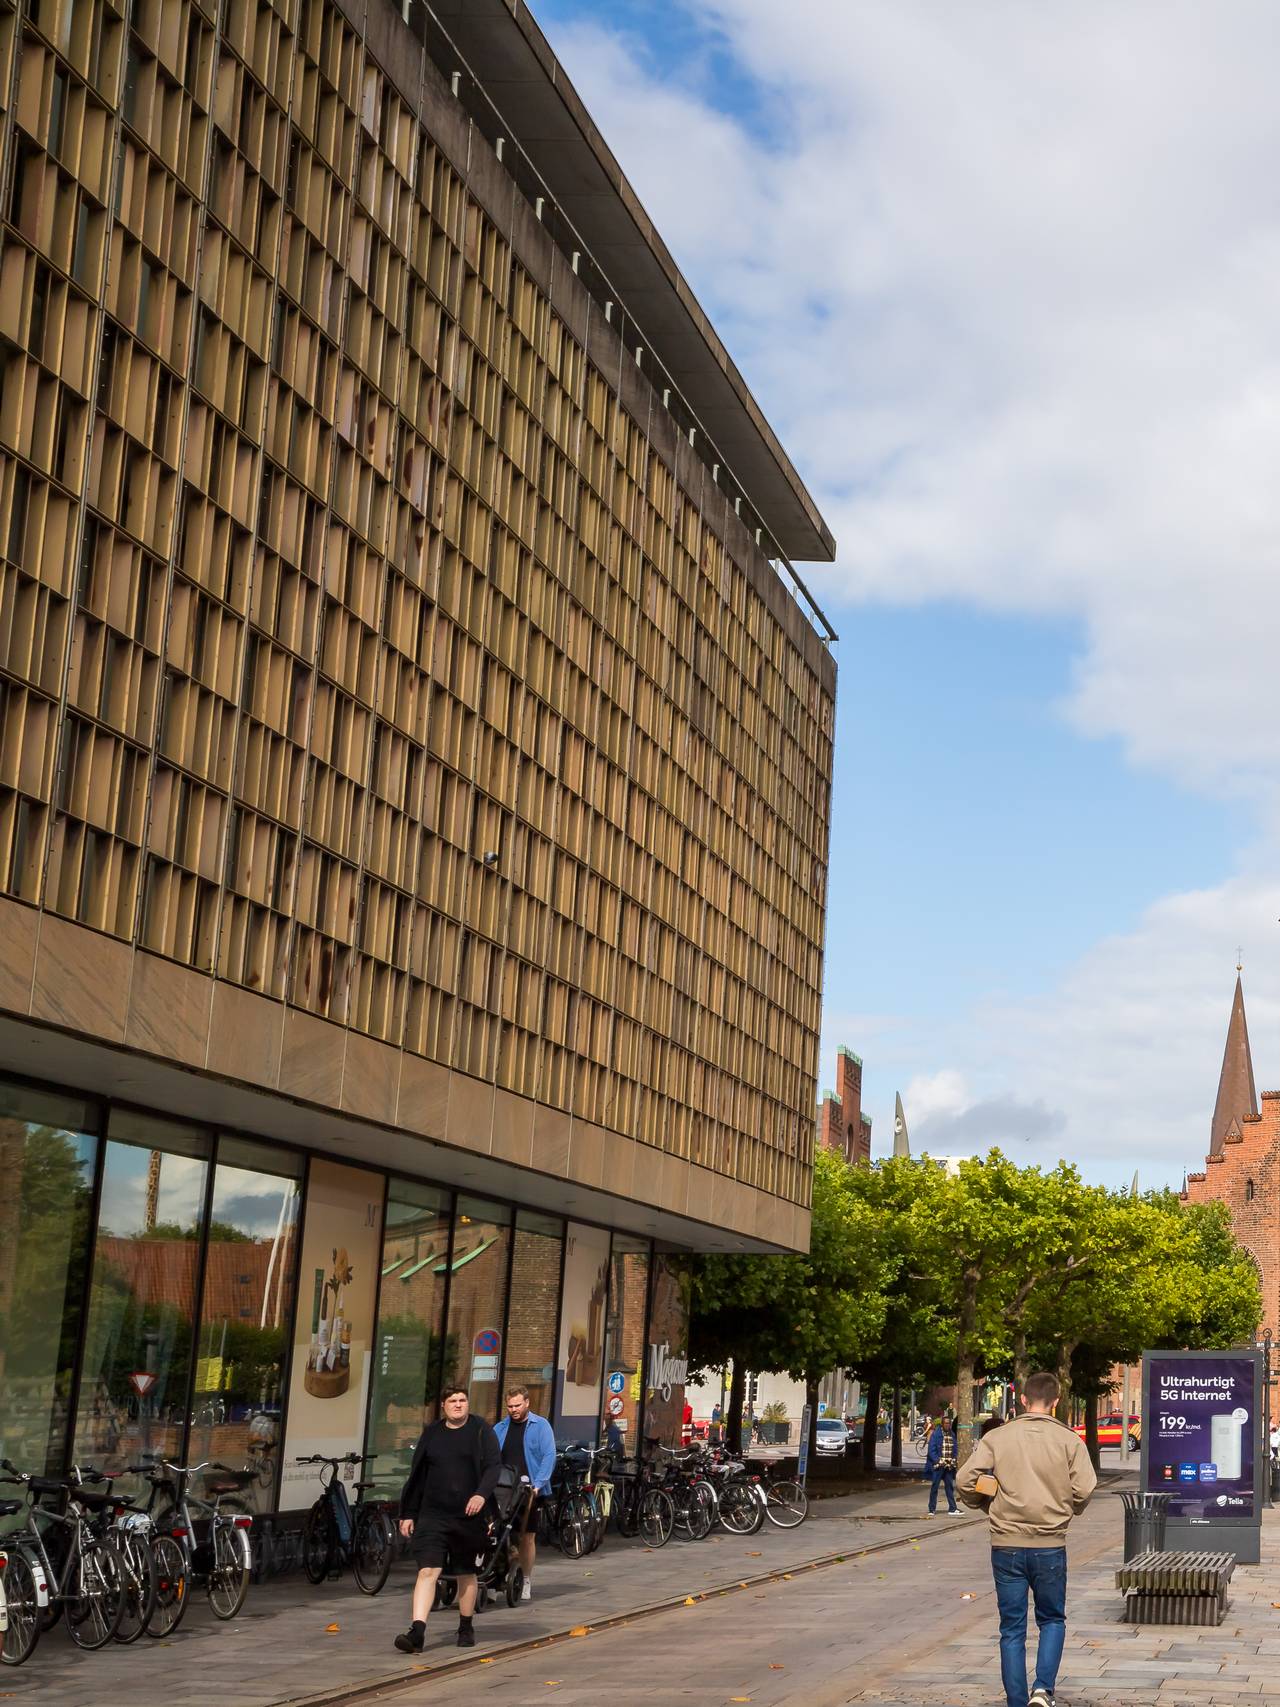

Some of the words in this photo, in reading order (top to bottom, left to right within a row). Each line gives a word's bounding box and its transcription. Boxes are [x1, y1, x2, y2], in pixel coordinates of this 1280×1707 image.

[648, 1343, 688, 1402] Magasin
[1160, 1376, 1235, 1389] Ultrahurtigt
[1160, 1390, 1179, 1400] 5G
[1181, 1390, 1232, 1400] Internet
[1159, 1416, 1186, 1430] 199
